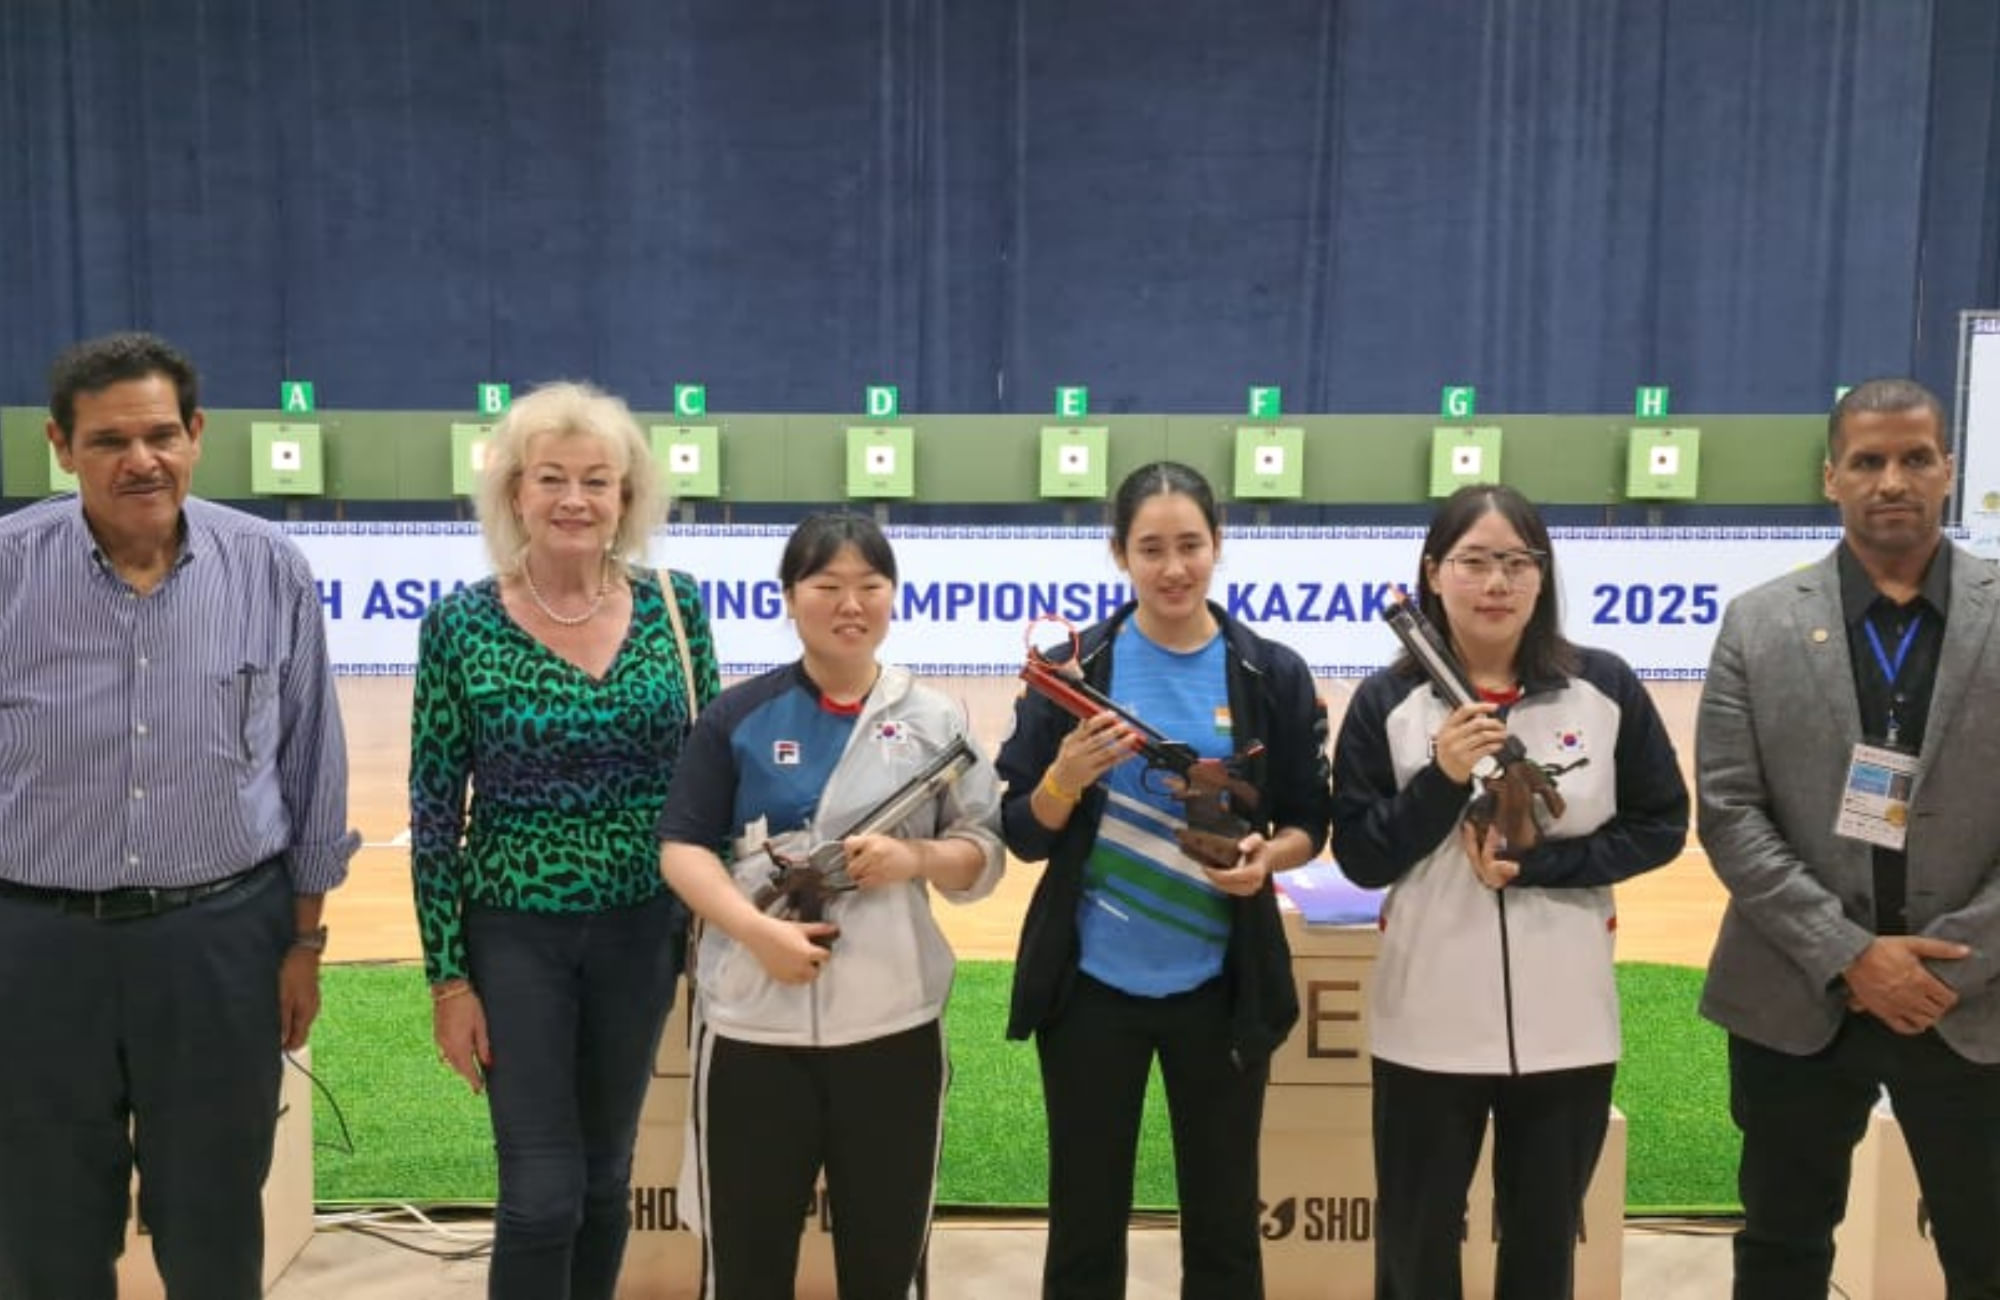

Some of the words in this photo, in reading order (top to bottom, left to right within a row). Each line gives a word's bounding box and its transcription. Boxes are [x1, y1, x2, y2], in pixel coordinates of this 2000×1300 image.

[289, 384, 307, 412] A
[486, 386, 502, 413] B
[680, 387, 700, 415] C
[872, 388, 892, 415] D
[1064, 388, 1080, 415] E
[1252, 388, 1268, 416] F
[1449, 388, 1468, 415] G
[1643, 388, 1661, 416] H
[362, 579, 466, 620] ASI
[890, 581, 1138, 622] MPIONSH
[1227, 582, 1420, 622] KAZAK
[1593, 584, 1719, 624] 2025
[1307, 981, 1359, 1058] E
[629, 1187, 690, 1231] HO
